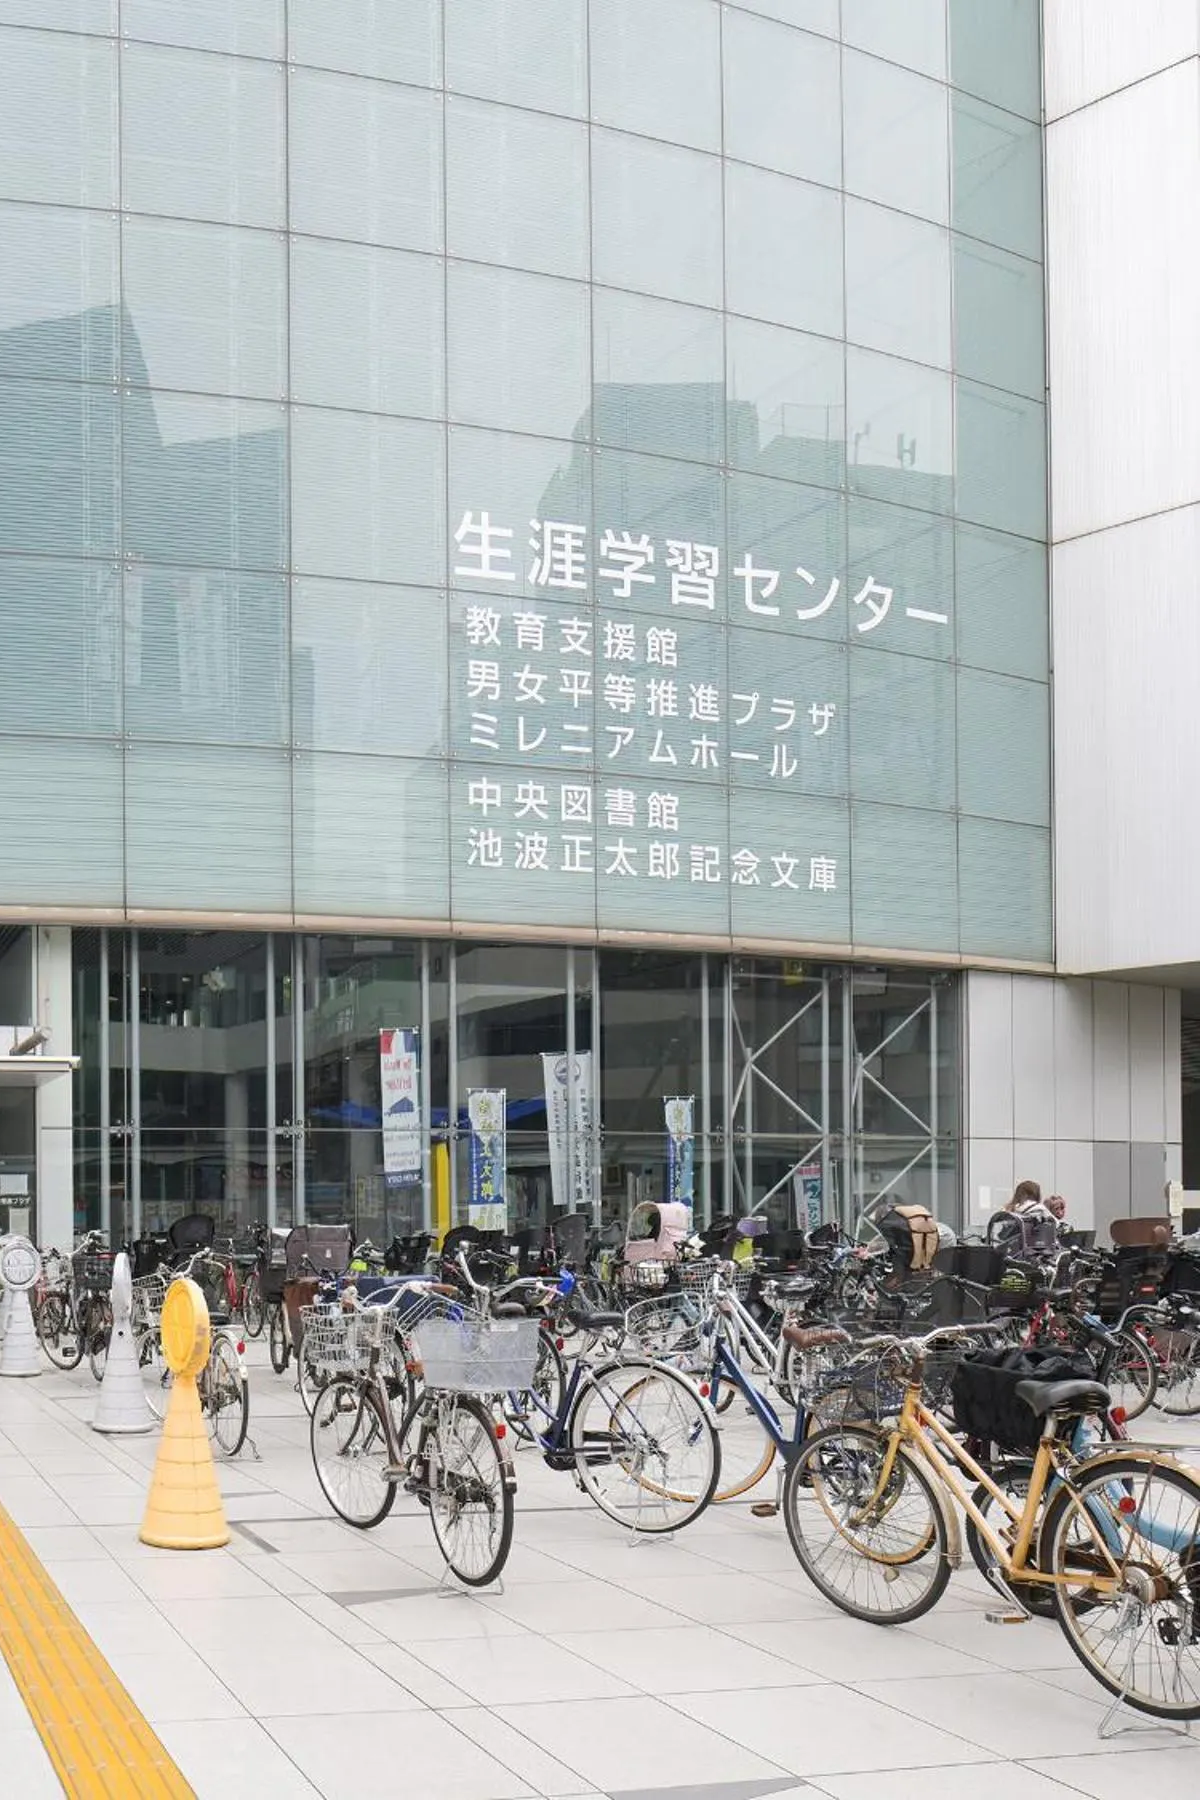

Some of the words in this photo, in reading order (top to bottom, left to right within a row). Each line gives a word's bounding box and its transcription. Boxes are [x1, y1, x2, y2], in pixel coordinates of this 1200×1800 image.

[454, 511, 949, 632] 生涯学習センター
[466, 606, 678, 667] 教育支援館
[467, 659, 836, 736] 男女平等推進プラザ
[469, 712, 798, 779] ミレニアムホール
[468, 777, 680, 832] 中央図書館
[467, 828, 838, 892] 池波正太郎記念文庫
